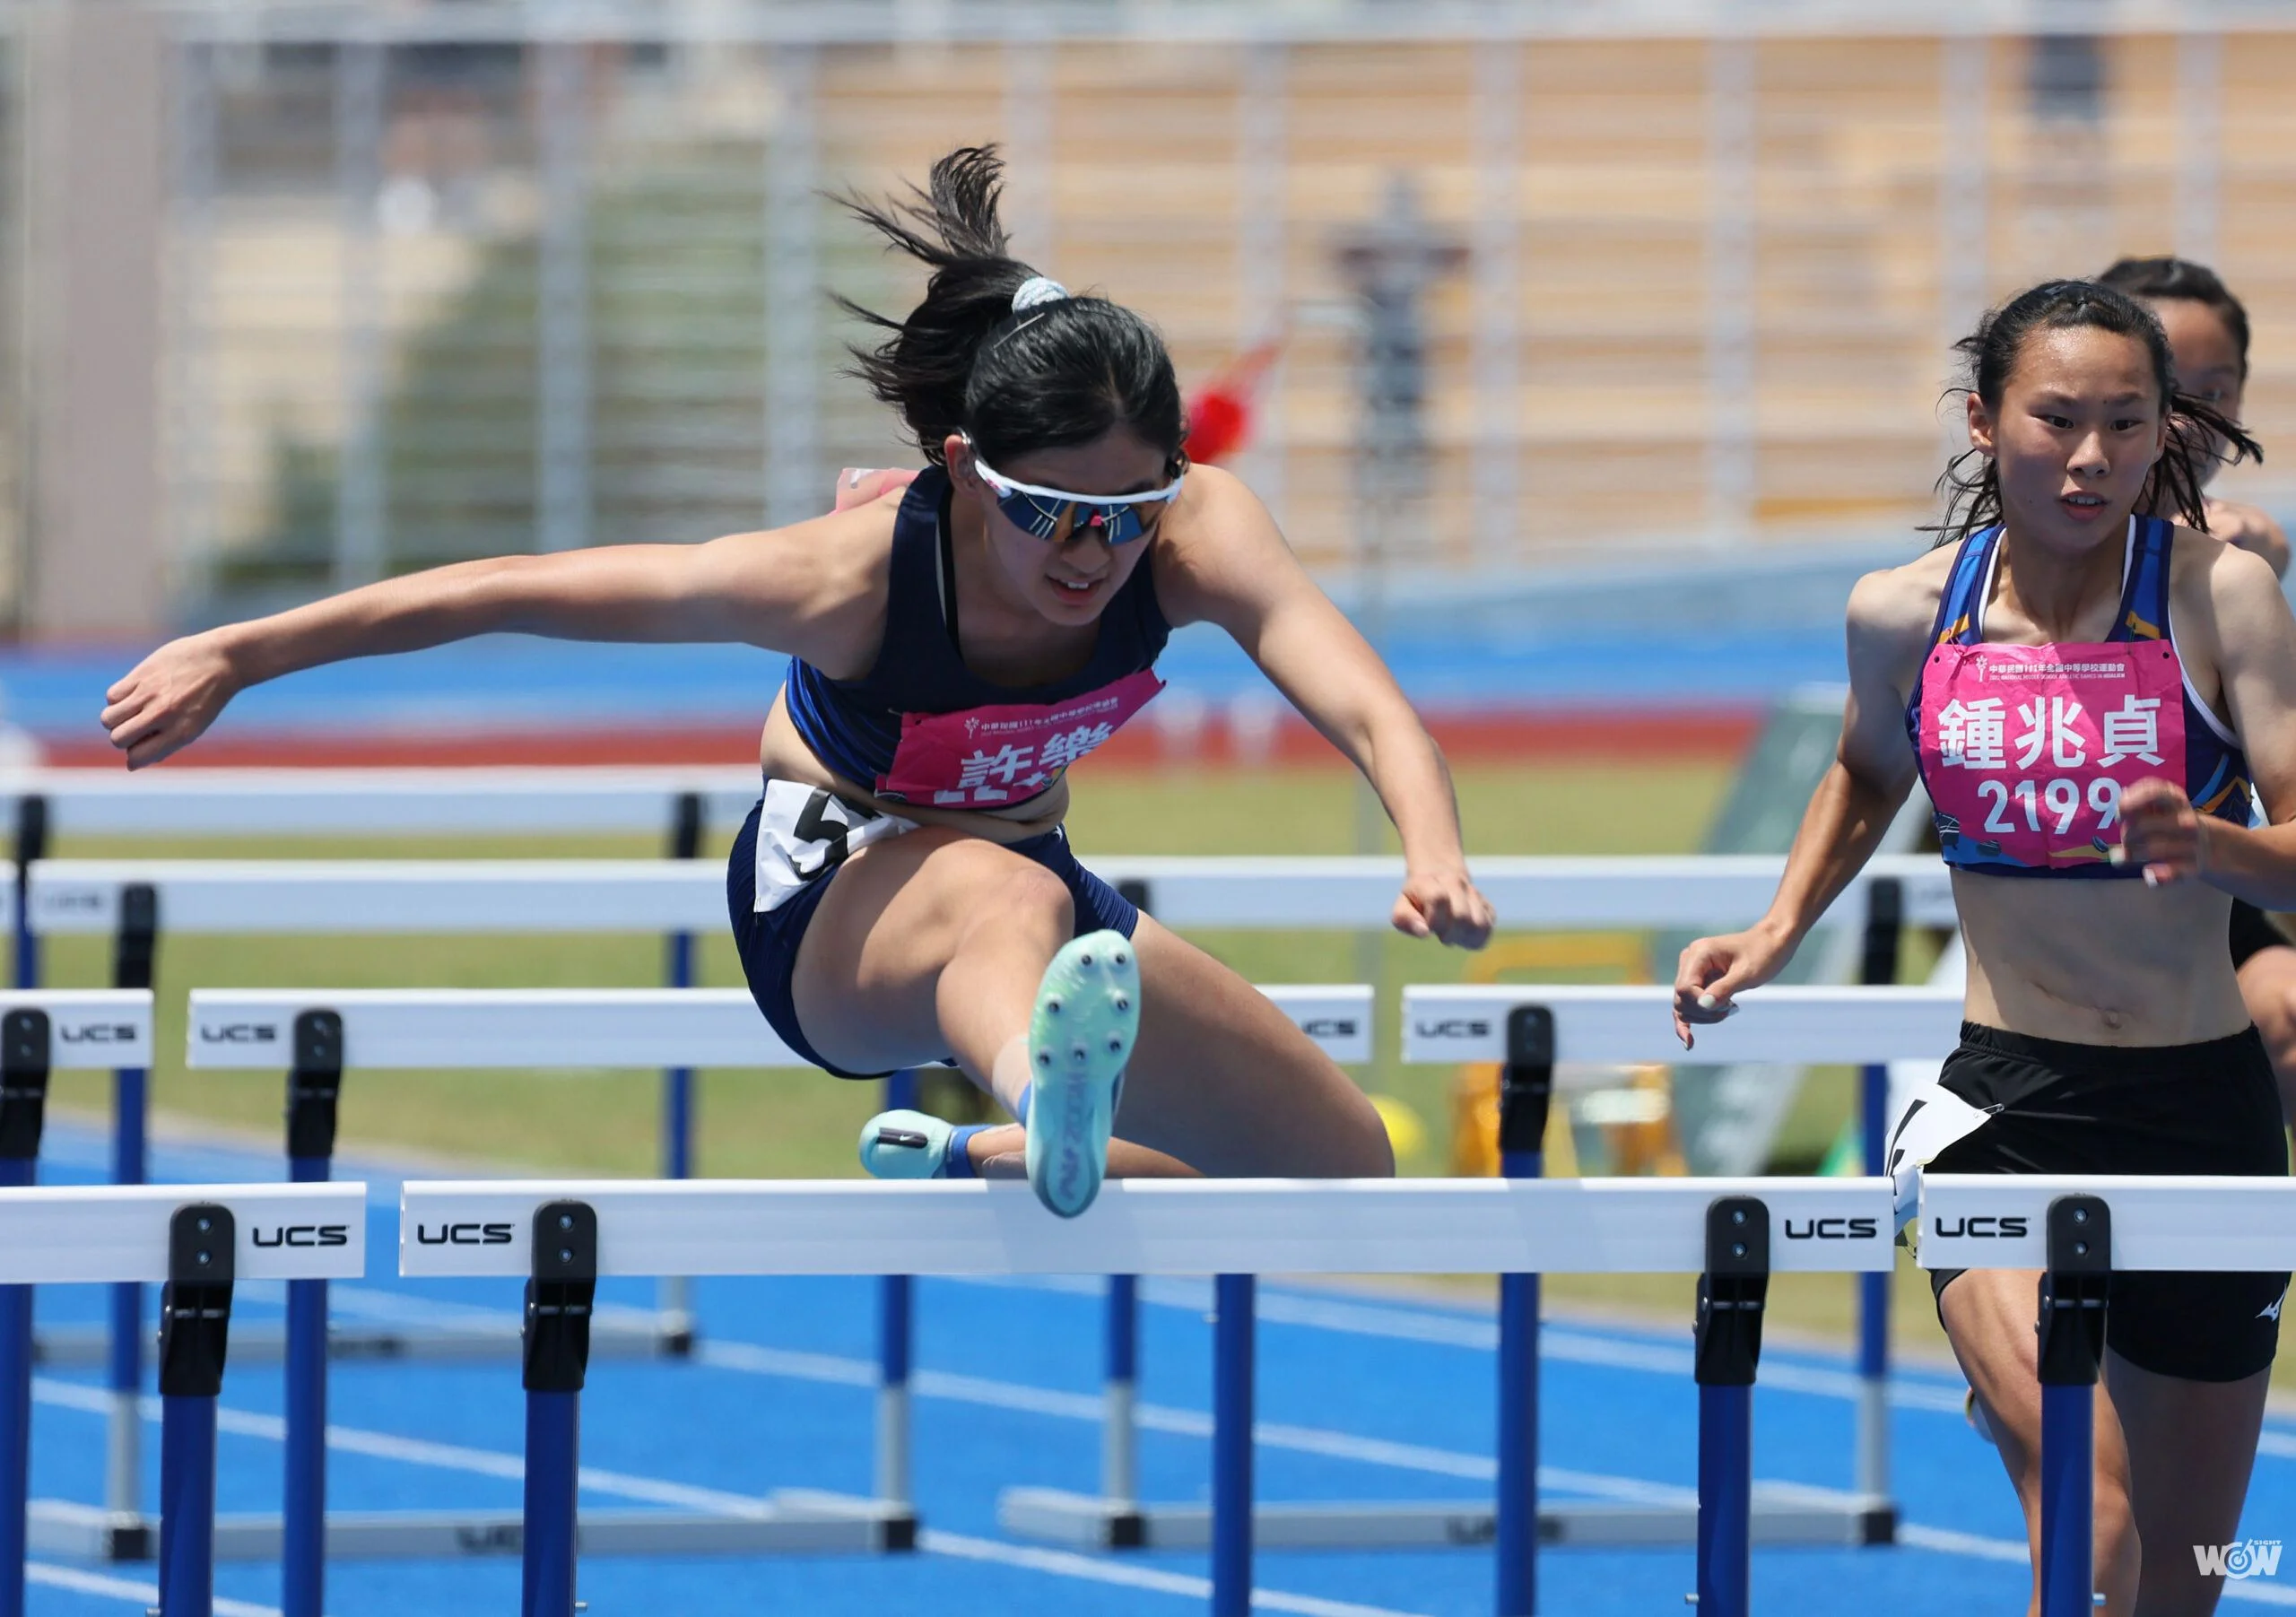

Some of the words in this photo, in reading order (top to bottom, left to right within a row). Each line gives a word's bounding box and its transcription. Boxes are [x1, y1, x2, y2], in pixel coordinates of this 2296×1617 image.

[1937, 694, 2166, 769] 鍾兆貞
[1978, 777, 2122, 835] 2199
[61, 1024, 137, 1043] UCS
[201, 1024, 277, 1043] UCS
[1303, 1019, 1357, 1038] CS
[1415, 1019, 1491, 1038] UCS
[252, 1225, 349, 1248] UCS
[417, 1223, 513, 1245] UCS
[1785, 1218, 1877, 1239] UCS
[1935, 1217, 2029, 1239] UCS
